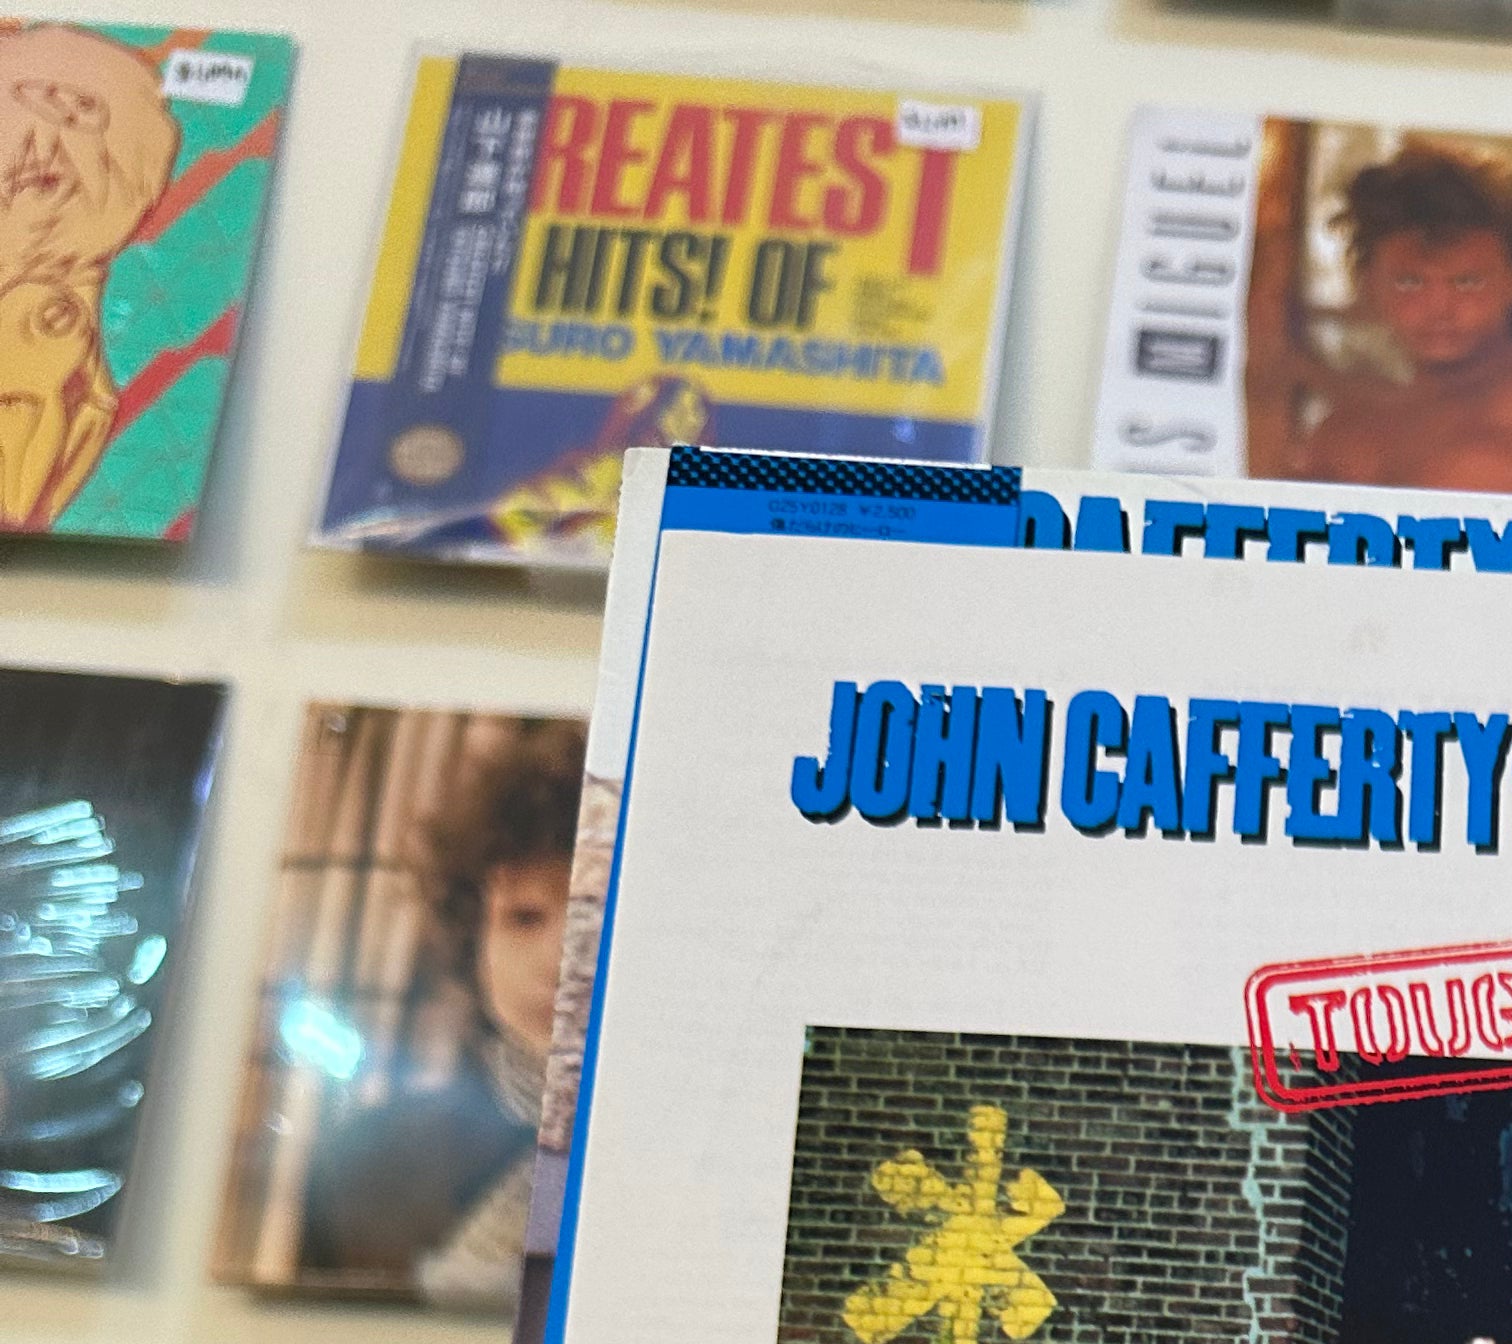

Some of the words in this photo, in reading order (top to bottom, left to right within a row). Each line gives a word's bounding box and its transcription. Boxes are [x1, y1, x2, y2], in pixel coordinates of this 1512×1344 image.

[531, 225, 720, 321] HITS!
[744, 233, 838, 335] OF
[789, 680, 1054, 833] JOHN
